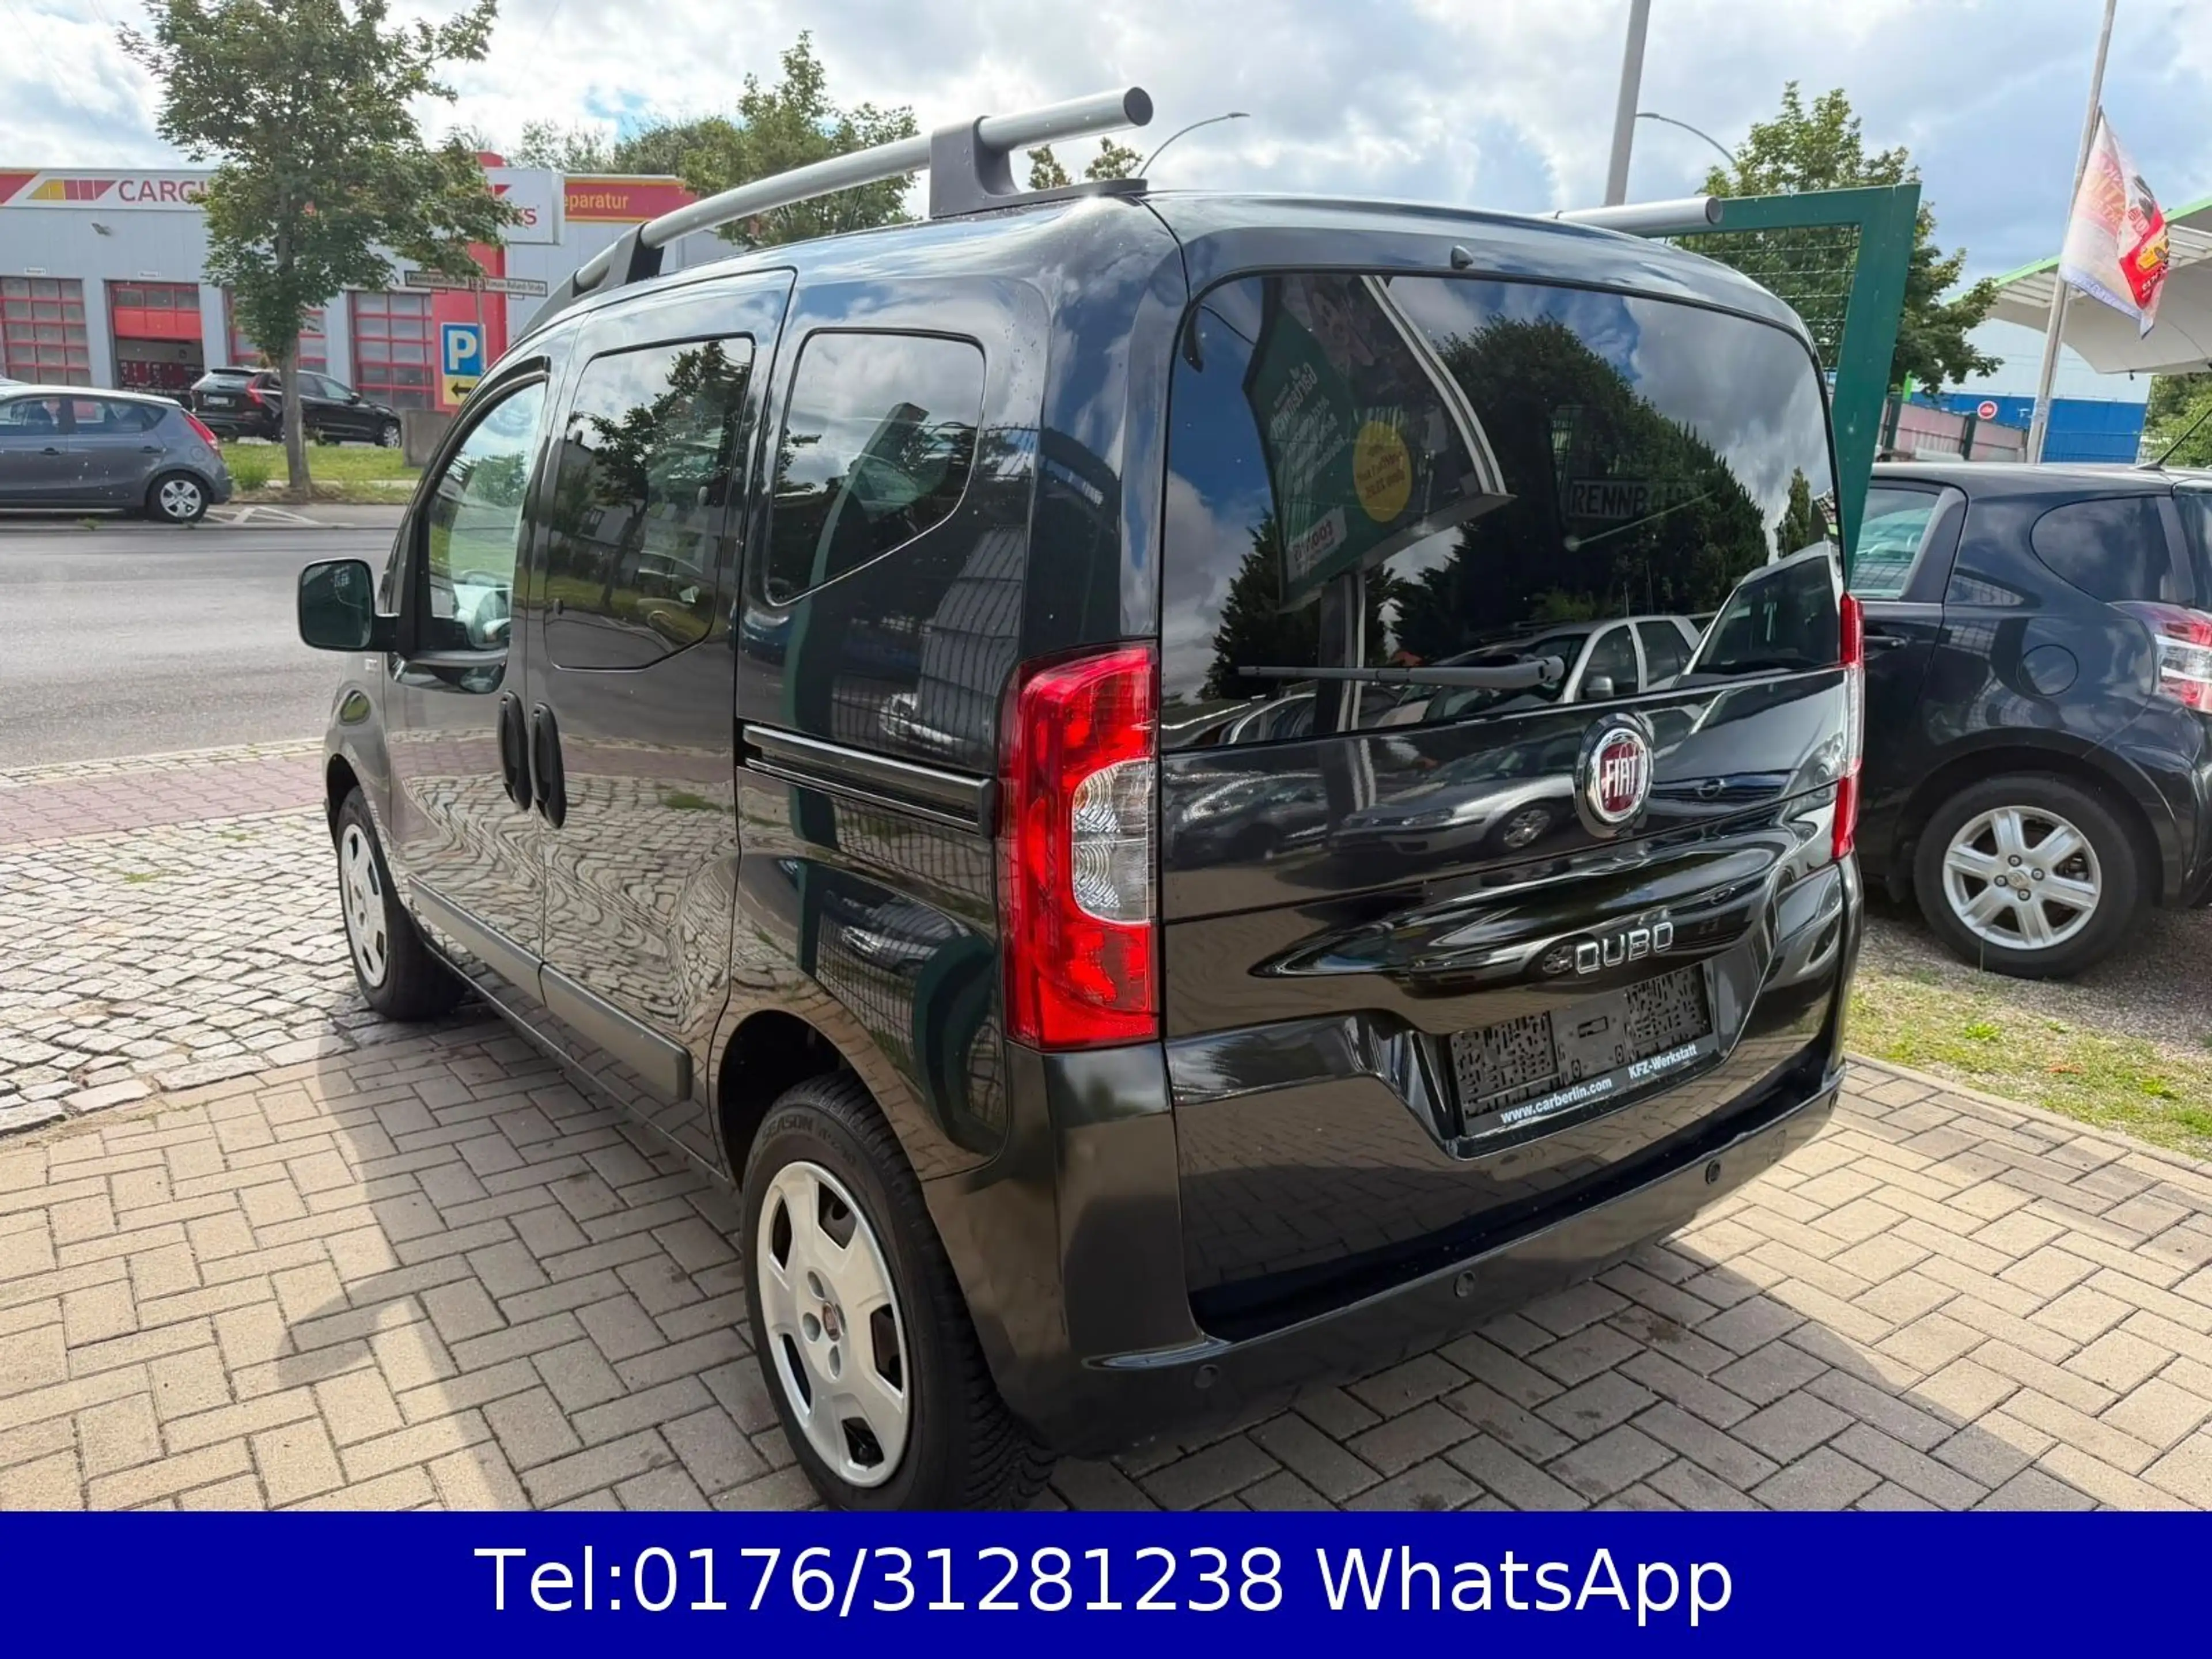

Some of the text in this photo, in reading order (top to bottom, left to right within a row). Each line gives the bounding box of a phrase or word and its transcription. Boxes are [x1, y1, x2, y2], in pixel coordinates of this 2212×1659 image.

[448, 330, 476, 370] P
[1604, 755, 1638, 799] FIAT
[1575, 922, 1673, 974] QUBO
[1501, 1043, 1698, 1123] www.carberlin.com KFZ-Werkstatt
